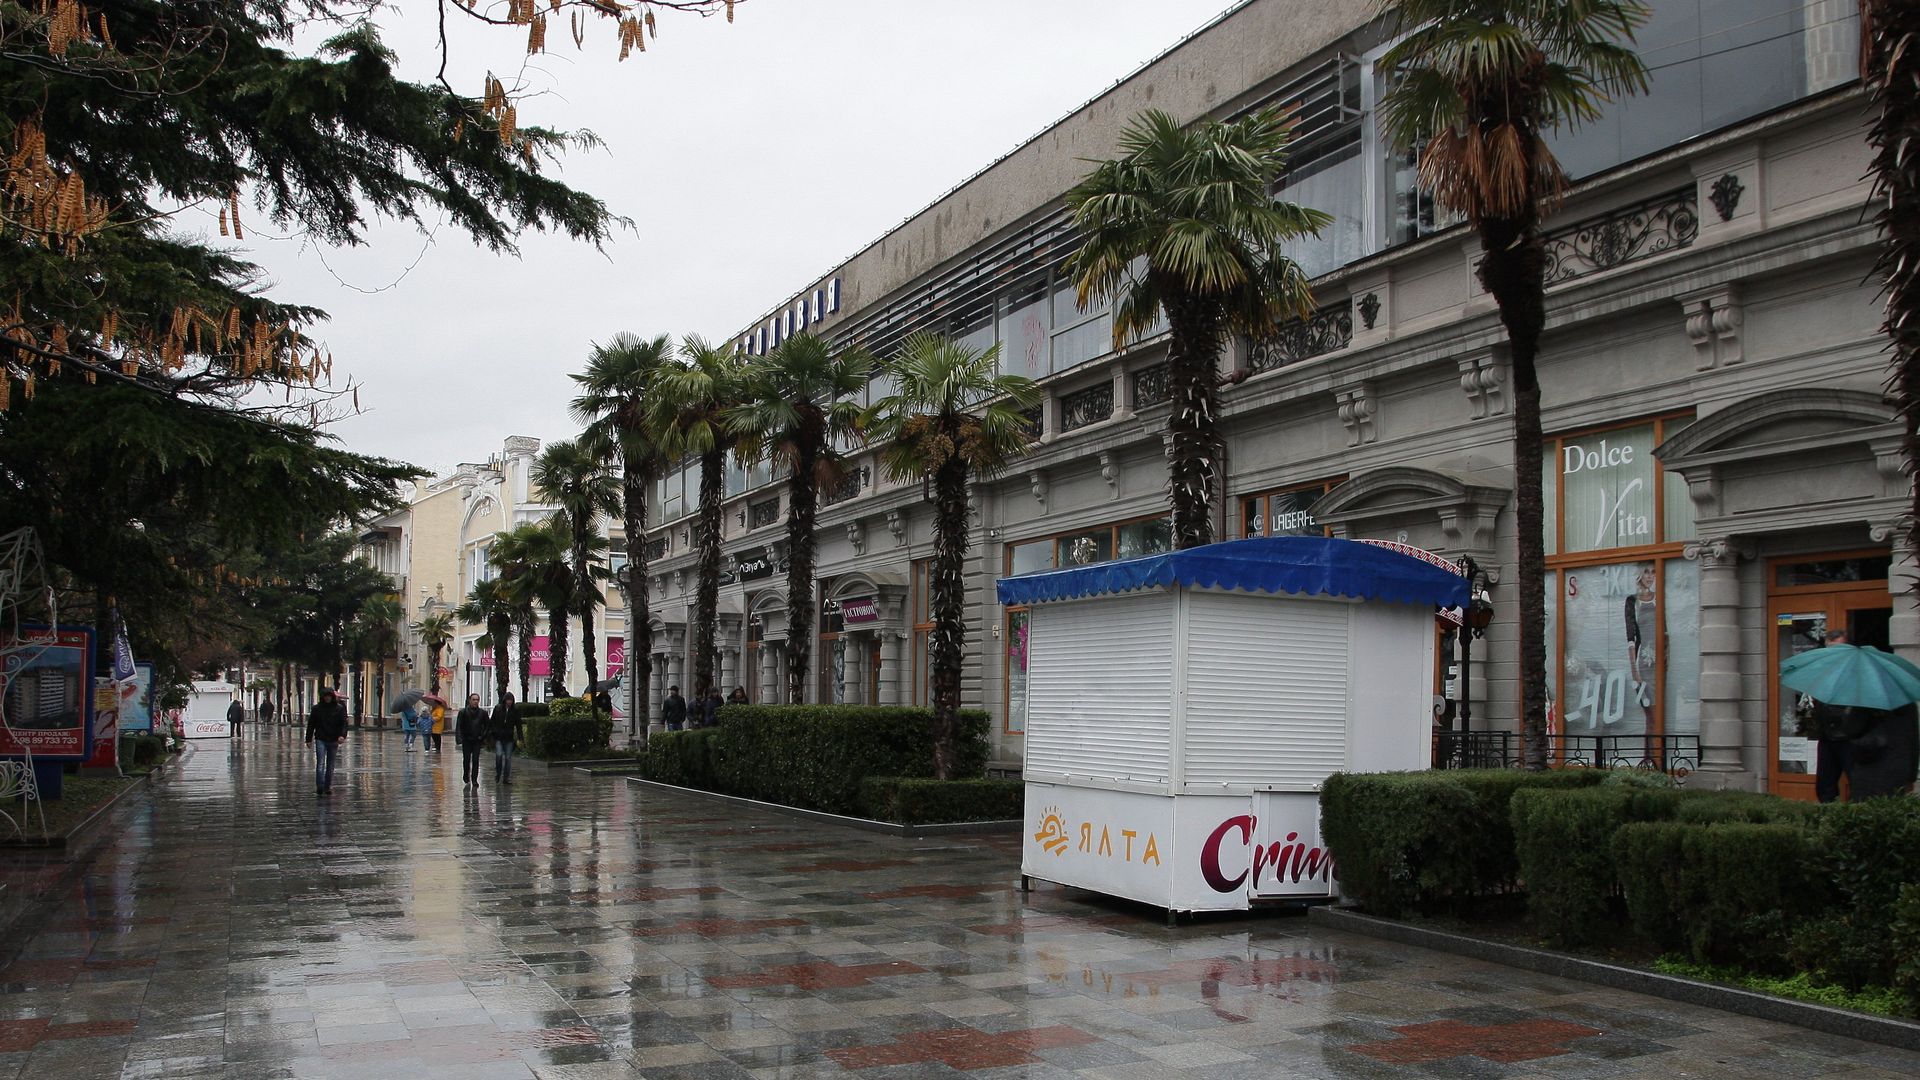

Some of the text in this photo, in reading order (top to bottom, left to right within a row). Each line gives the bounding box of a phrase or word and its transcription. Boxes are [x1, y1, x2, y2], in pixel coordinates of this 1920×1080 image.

[1563, 439, 1633, 474] Dolce
[1595, 477, 1648, 547] Vita
[843, 604, 876, 618] ГАСТРОНОМ
[1564, 669, 1650, 730] -40%
[1078, 822, 1161, 867] ЯЛТА
[1200, 814, 1341, 893] Crim
